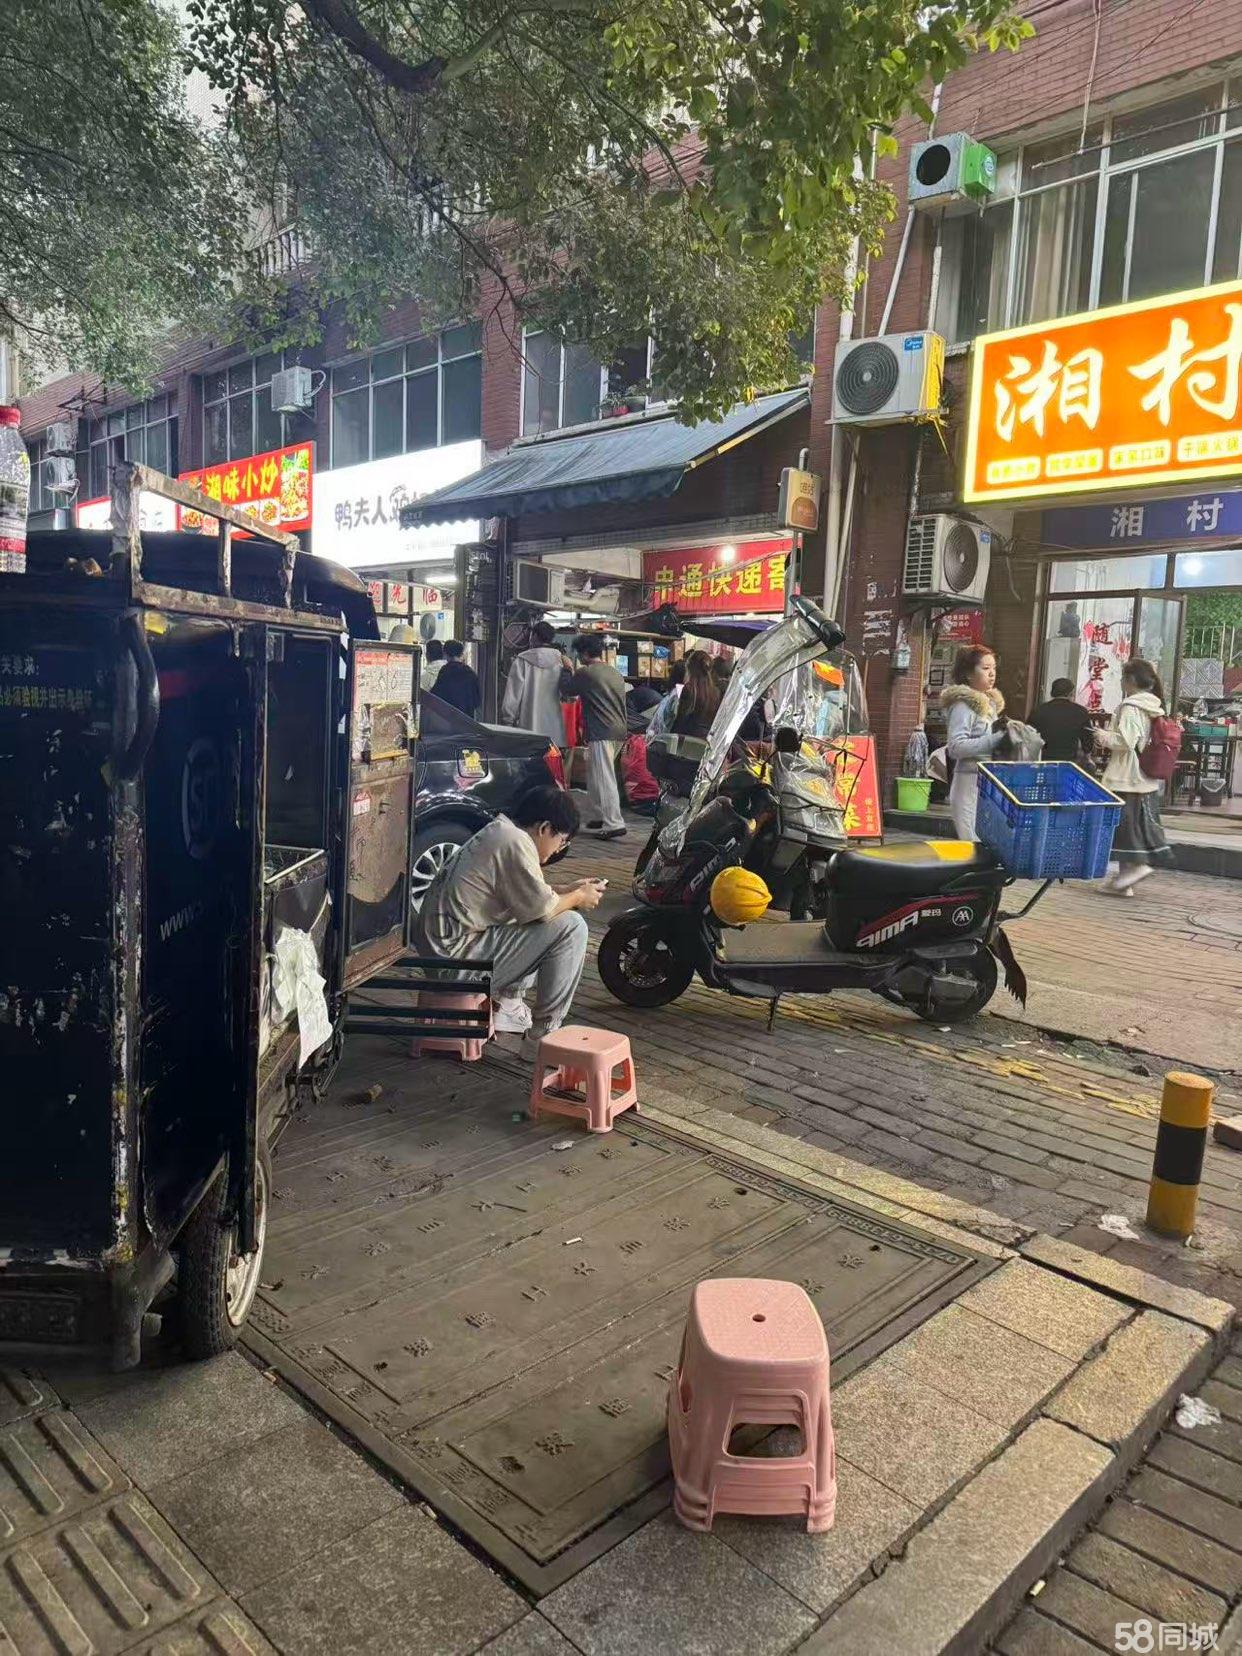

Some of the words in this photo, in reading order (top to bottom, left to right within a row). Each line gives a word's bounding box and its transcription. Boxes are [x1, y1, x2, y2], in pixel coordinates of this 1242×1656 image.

[994, 303, 1242, 443] 湘村
[205, 457, 279, 501] 湘味小炒
[1109, 497, 1224, 538] 湘村
